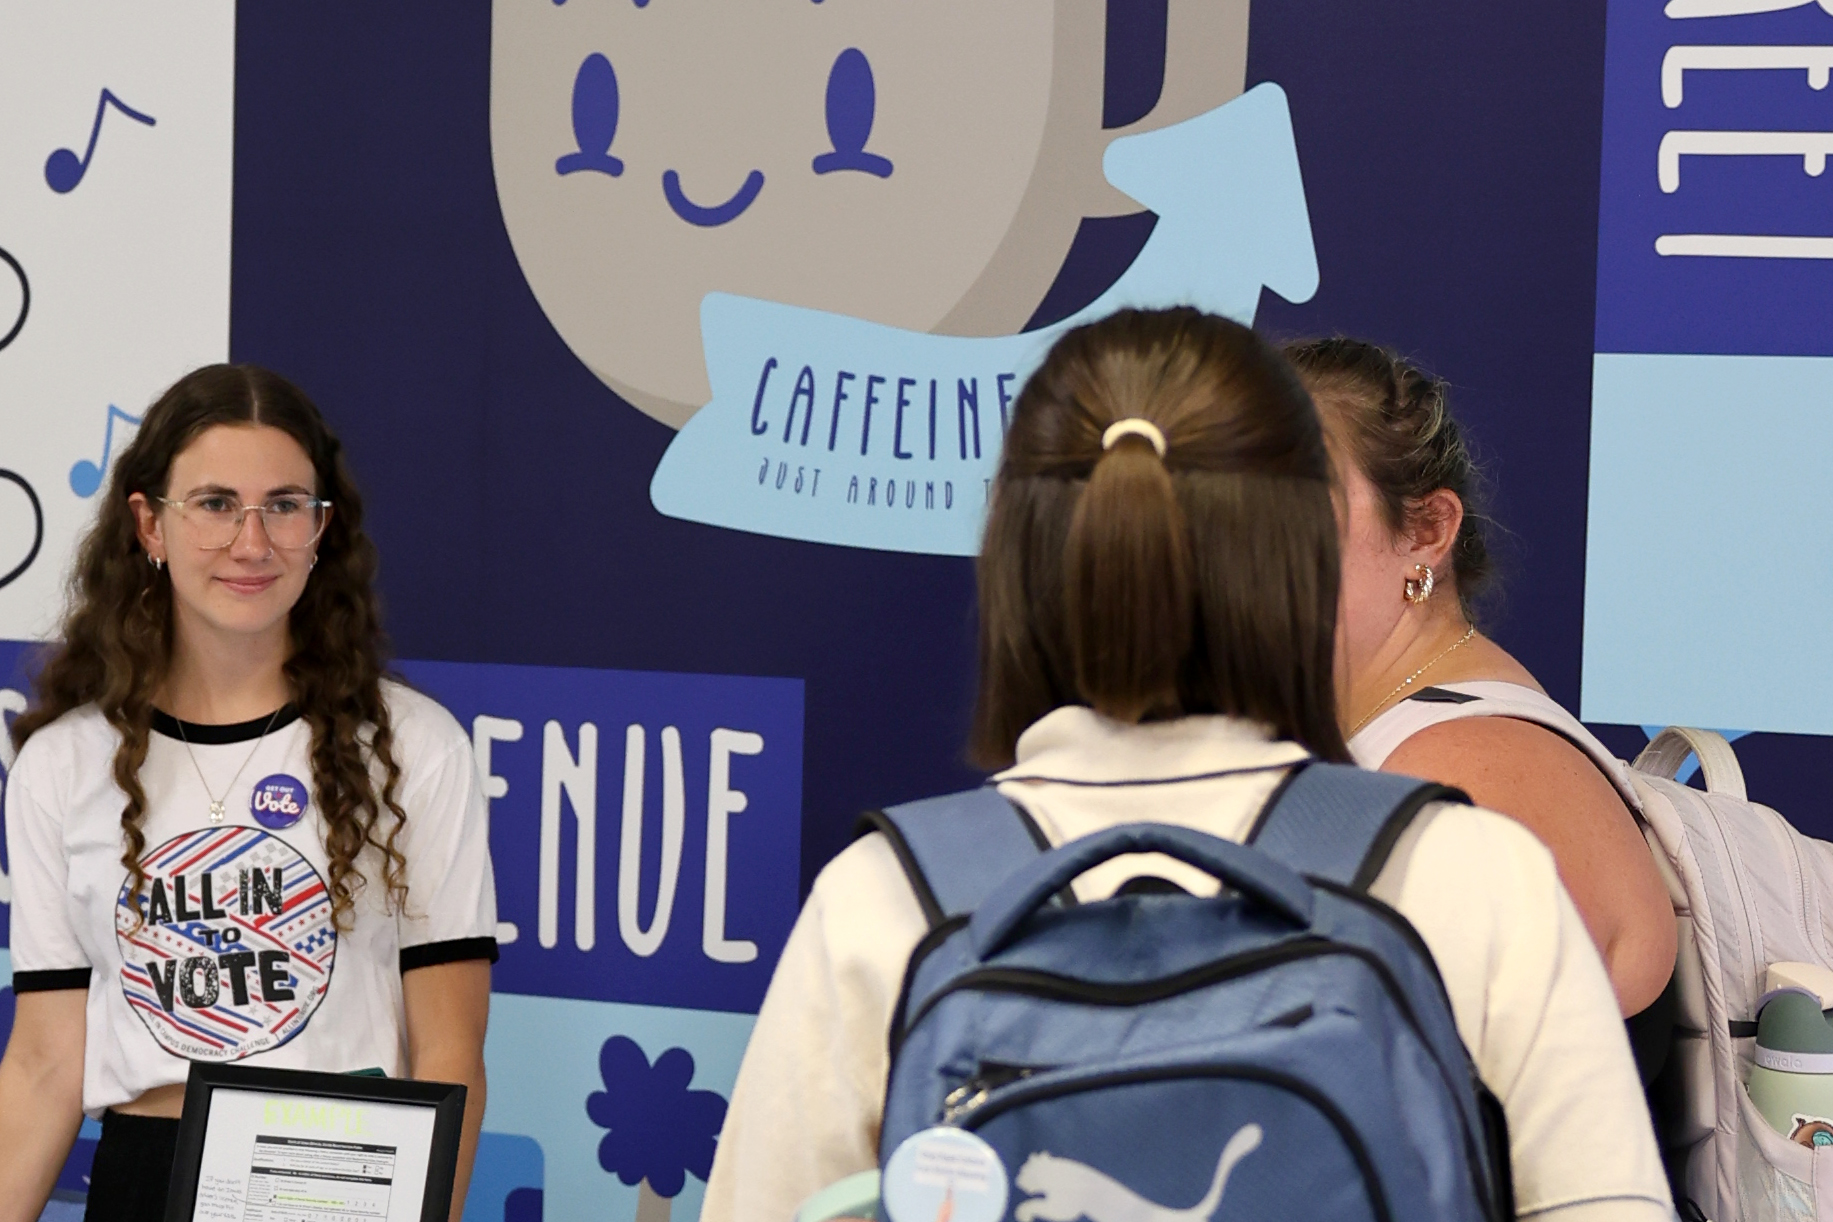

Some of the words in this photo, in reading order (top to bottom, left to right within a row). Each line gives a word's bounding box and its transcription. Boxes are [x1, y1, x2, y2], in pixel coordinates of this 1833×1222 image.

[758, 456, 821, 498] JUST
[845, 474, 954, 511] AROUND
[254, 790, 301, 815] Vote
[148, 872, 227, 926] ALL
[239, 867, 283, 916] IN
[198, 926, 242, 946] TO
[145, 949, 296, 1013] VOTE
[180, 1043, 229, 1058] DEMOCRACY
[229, 1036, 271, 1056] CHALLENGE
[263, 1099, 373, 1137] EXAMPLE
